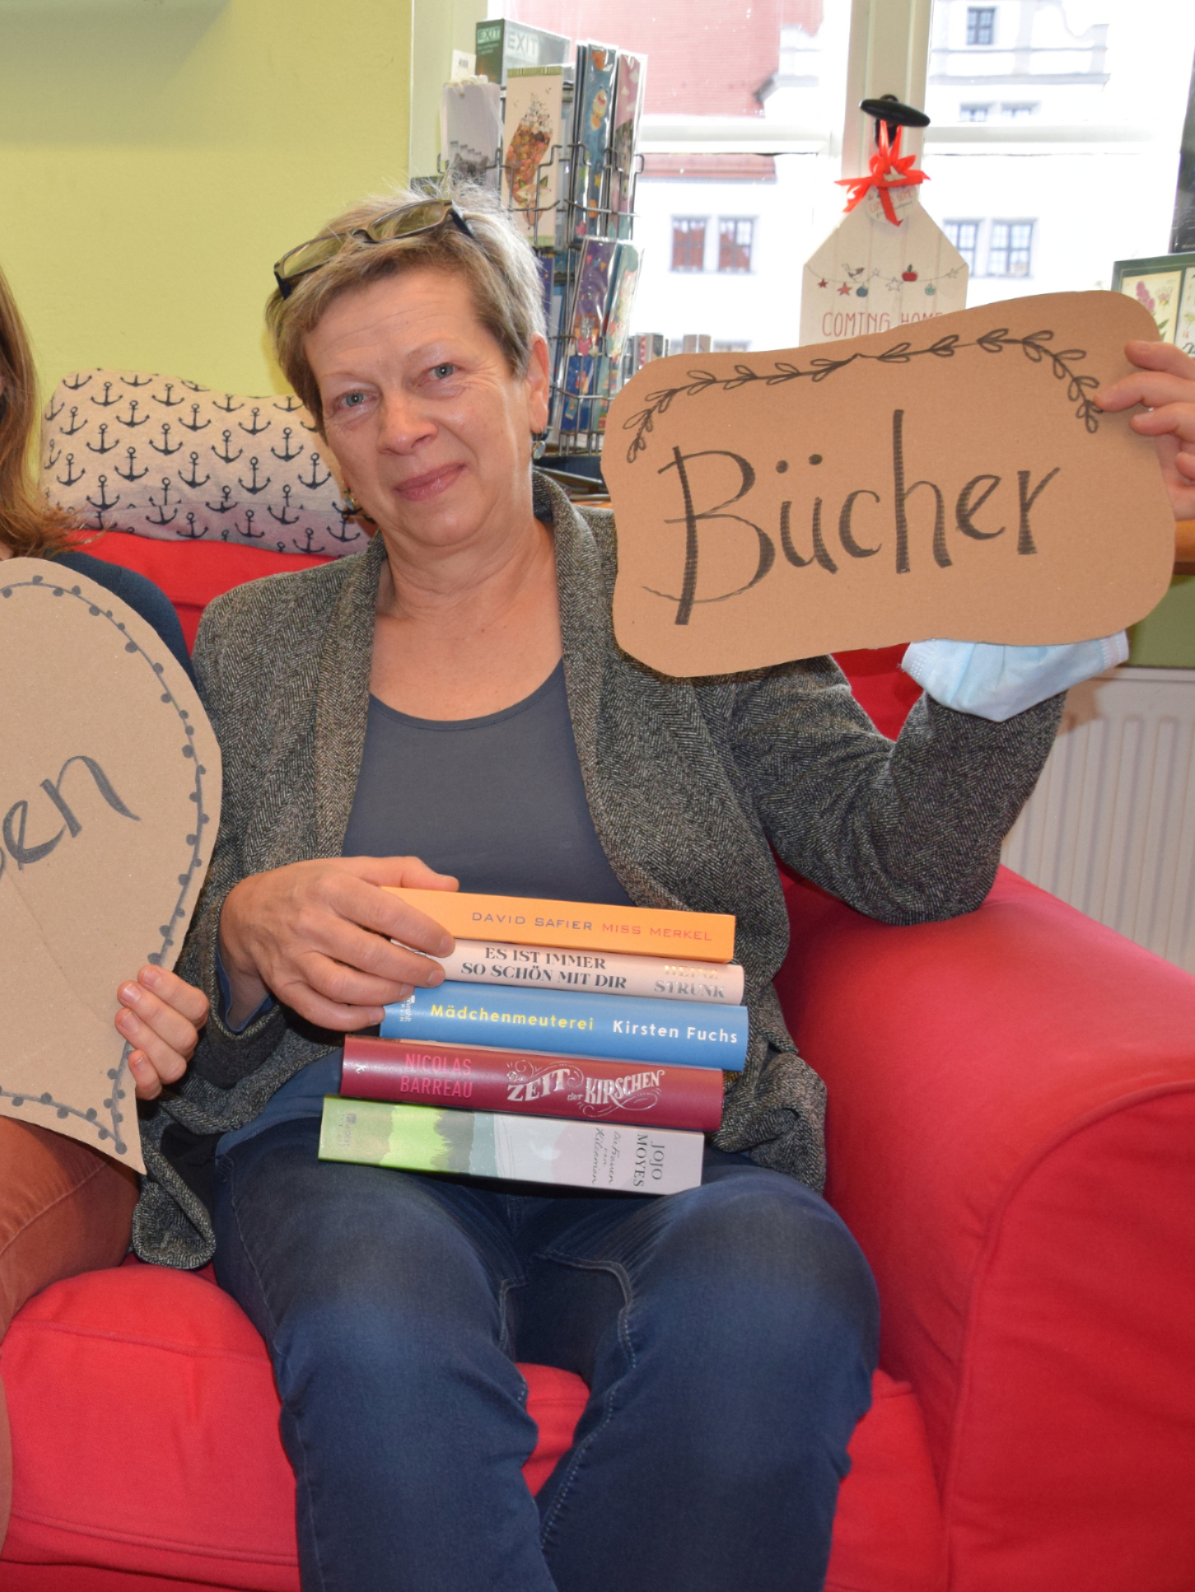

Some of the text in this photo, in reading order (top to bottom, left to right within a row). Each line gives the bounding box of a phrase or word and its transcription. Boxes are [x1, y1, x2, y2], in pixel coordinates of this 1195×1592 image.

[507, 29, 538, 58] EXIT
[822, 312, 890, 337] COMING
[642, 409, 1061, 626] Bücher
[472, 912, 713, 941] DAVID SAFIER MISS MERKEL
[485, 947, 606, 969] ES IST IMMER
[461, 962, 627, 989] SO SCHÖN MIT DIR
[654, 980, 725, 998] STRUNK
[430, 1004, 737, 1043] Mädchenmeuterei Kirsten Fuchs
[405, 1053, 472, 1076] NICOLAS
[400, 1076, 473, 1098] BARREAU
[507, 1068, 665, 1106] ZEIT der KIRSCHEN
[633, 1134, 648, 1187] MOYES
[649, 1141, 665, 1180] JOJO
